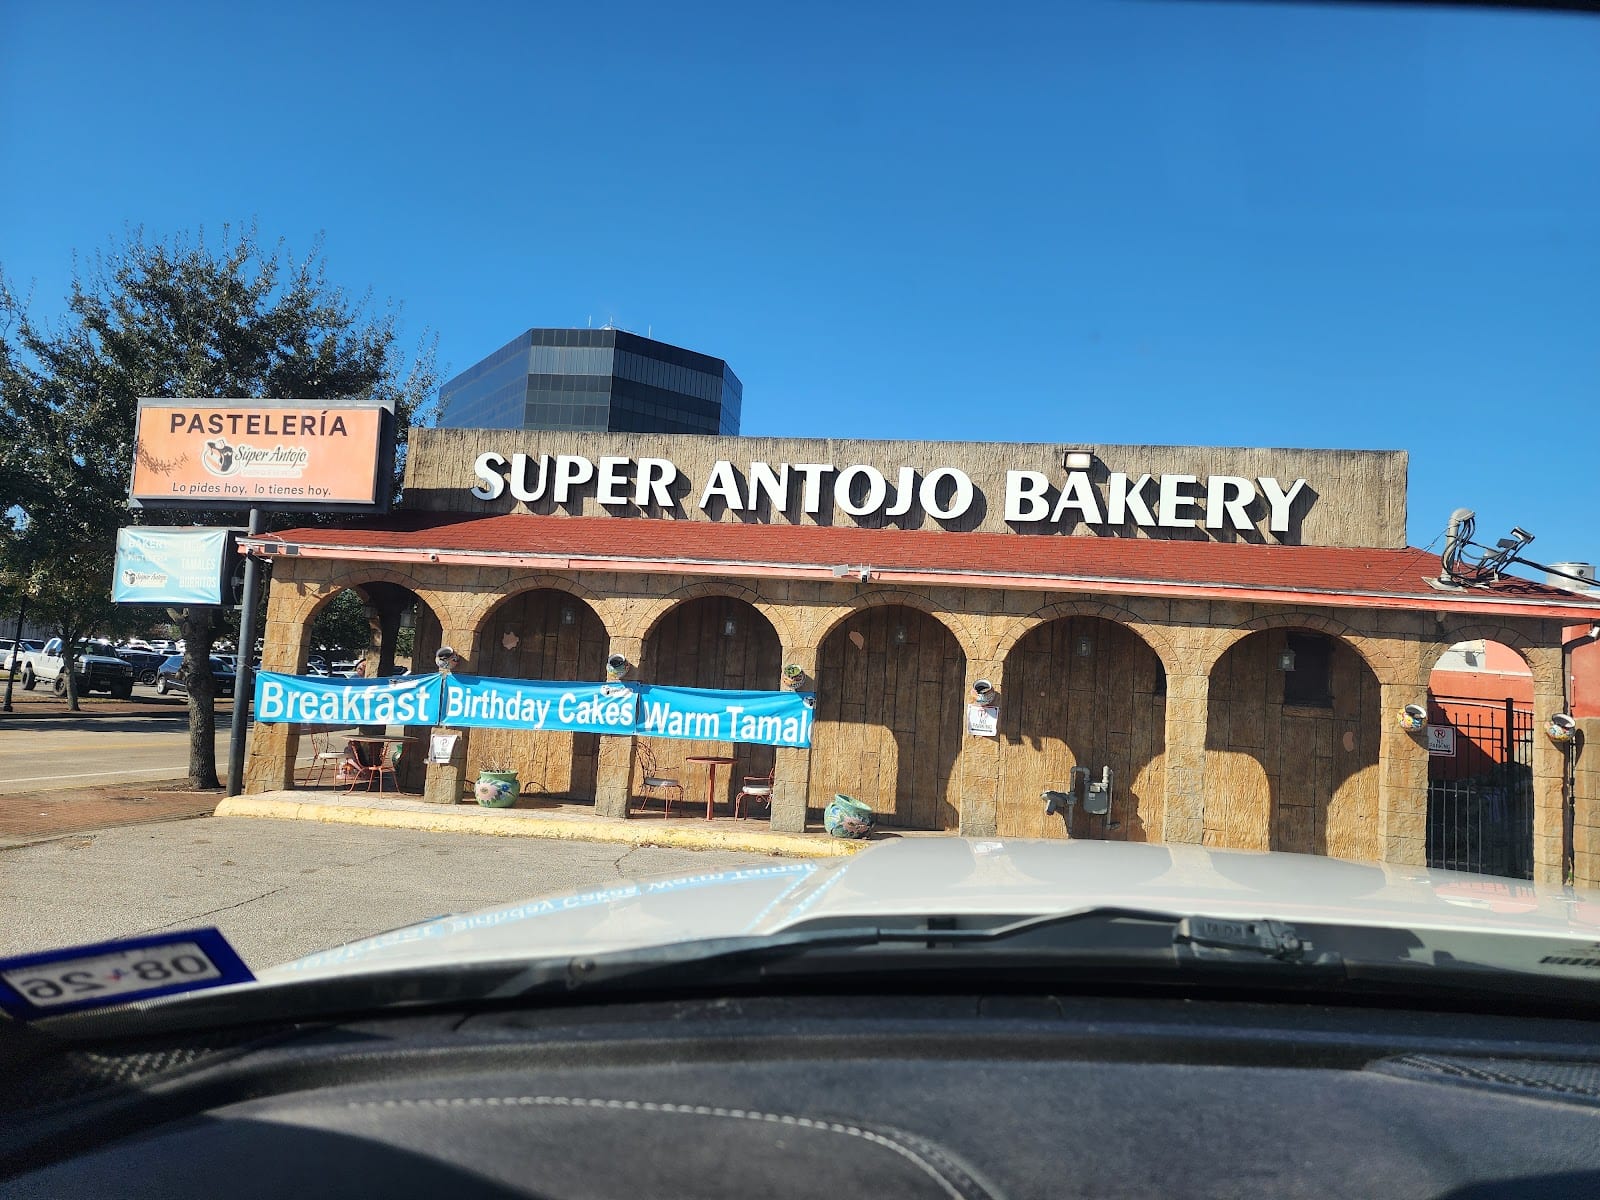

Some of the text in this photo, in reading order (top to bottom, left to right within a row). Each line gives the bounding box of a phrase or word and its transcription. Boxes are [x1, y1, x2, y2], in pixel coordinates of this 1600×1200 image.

[170, 410, 348, 437] PASTELERÍA
[271, 445, 307, 468] Antojo
[172, 482, 186, 493] Lo
[189, 482, 221, 495] pides
[254, 484, 265, 494] lo
[269, 485, 304, 495] tienes
[308, 484, 331, 496] hoy.
[470, 451, 1307, 532] SUPER ANTOJO BAKERY
[259, 681, 431, 721] Breakfast
[447, 686, 633, 729] Birthday Cakes
[644, 701, 720, 738] Warm
